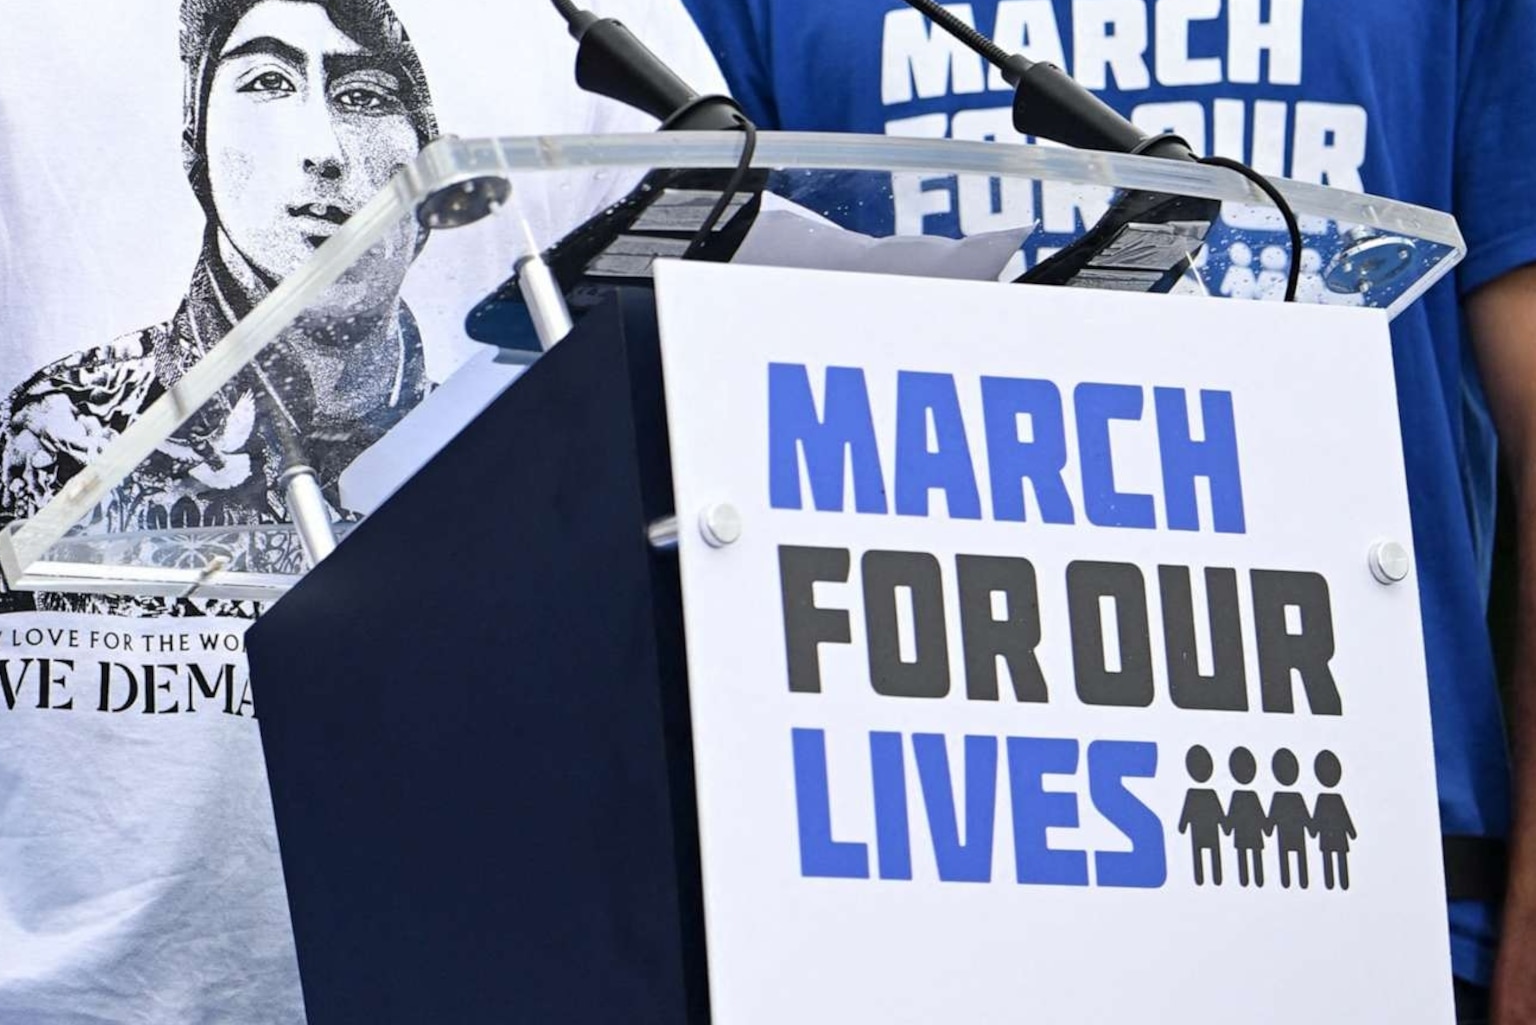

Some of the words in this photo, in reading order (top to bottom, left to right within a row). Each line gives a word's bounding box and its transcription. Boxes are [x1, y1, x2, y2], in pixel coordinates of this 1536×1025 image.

[768, 362, 1246, 534] MARCH
[12, 628, 79, 648] LOVE
[89, 631, 134, 652] FOR
[141, 633, 191, 653] THE
[777, 544, 1049, 704] FOR
[1065, 559, 1343, 716] OUR
[791, 727, 1168, 888] LIVES
